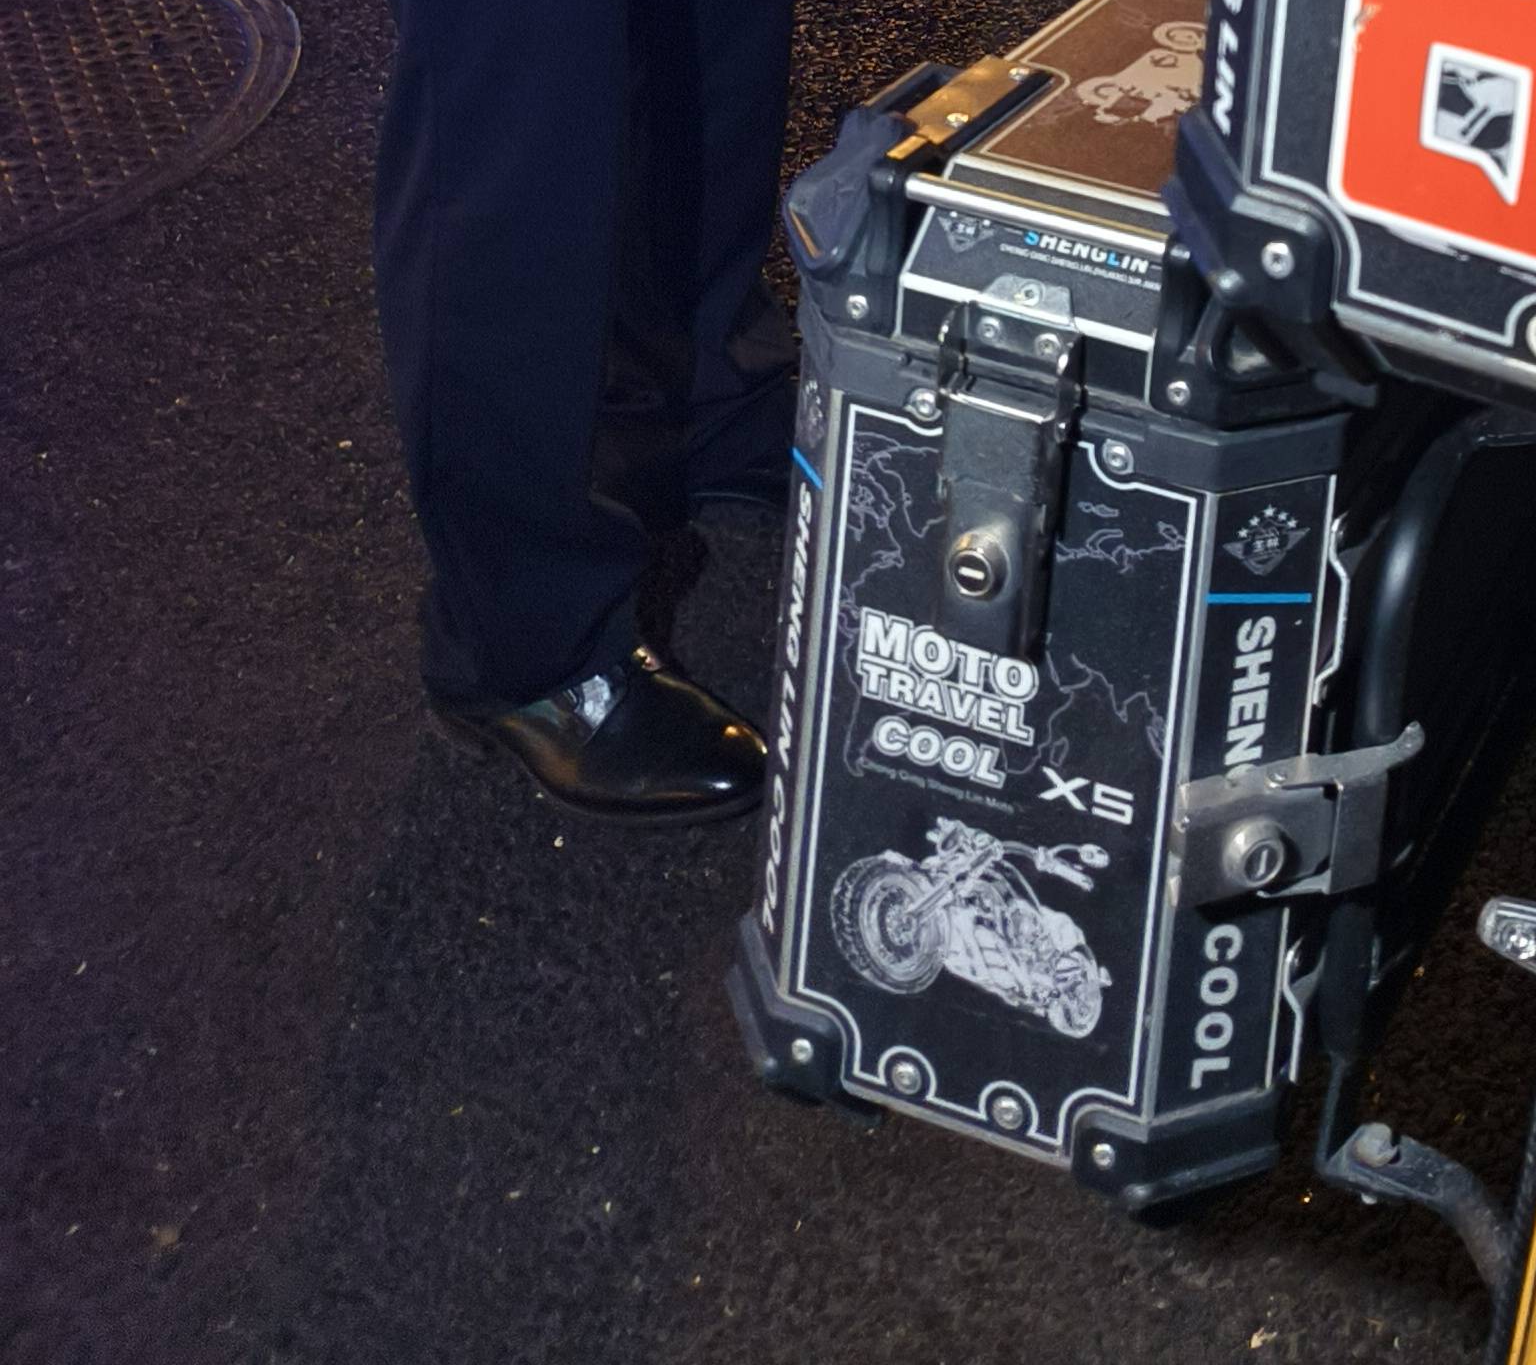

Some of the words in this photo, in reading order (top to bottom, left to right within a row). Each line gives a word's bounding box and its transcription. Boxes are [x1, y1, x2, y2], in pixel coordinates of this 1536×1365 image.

[1212, 19, 1239, 138] LIN
[1023, 229, 1150, 275] SHENGLIN
[784, 481, 813, 669] SHENG
[859, 608, 1038, 702] MOTO
[860, 663, 1034, 746] TRAVEL
[1224, 615, 1277, 779] SHEN
[777, 670, 796, 770] LIN
[873, 716, 1007, 788] COOL
[1038, 766, 1134, 825] X5
[761, 774, 786, 934] COOL
[1190, 922, 1244, 1091] COOL
